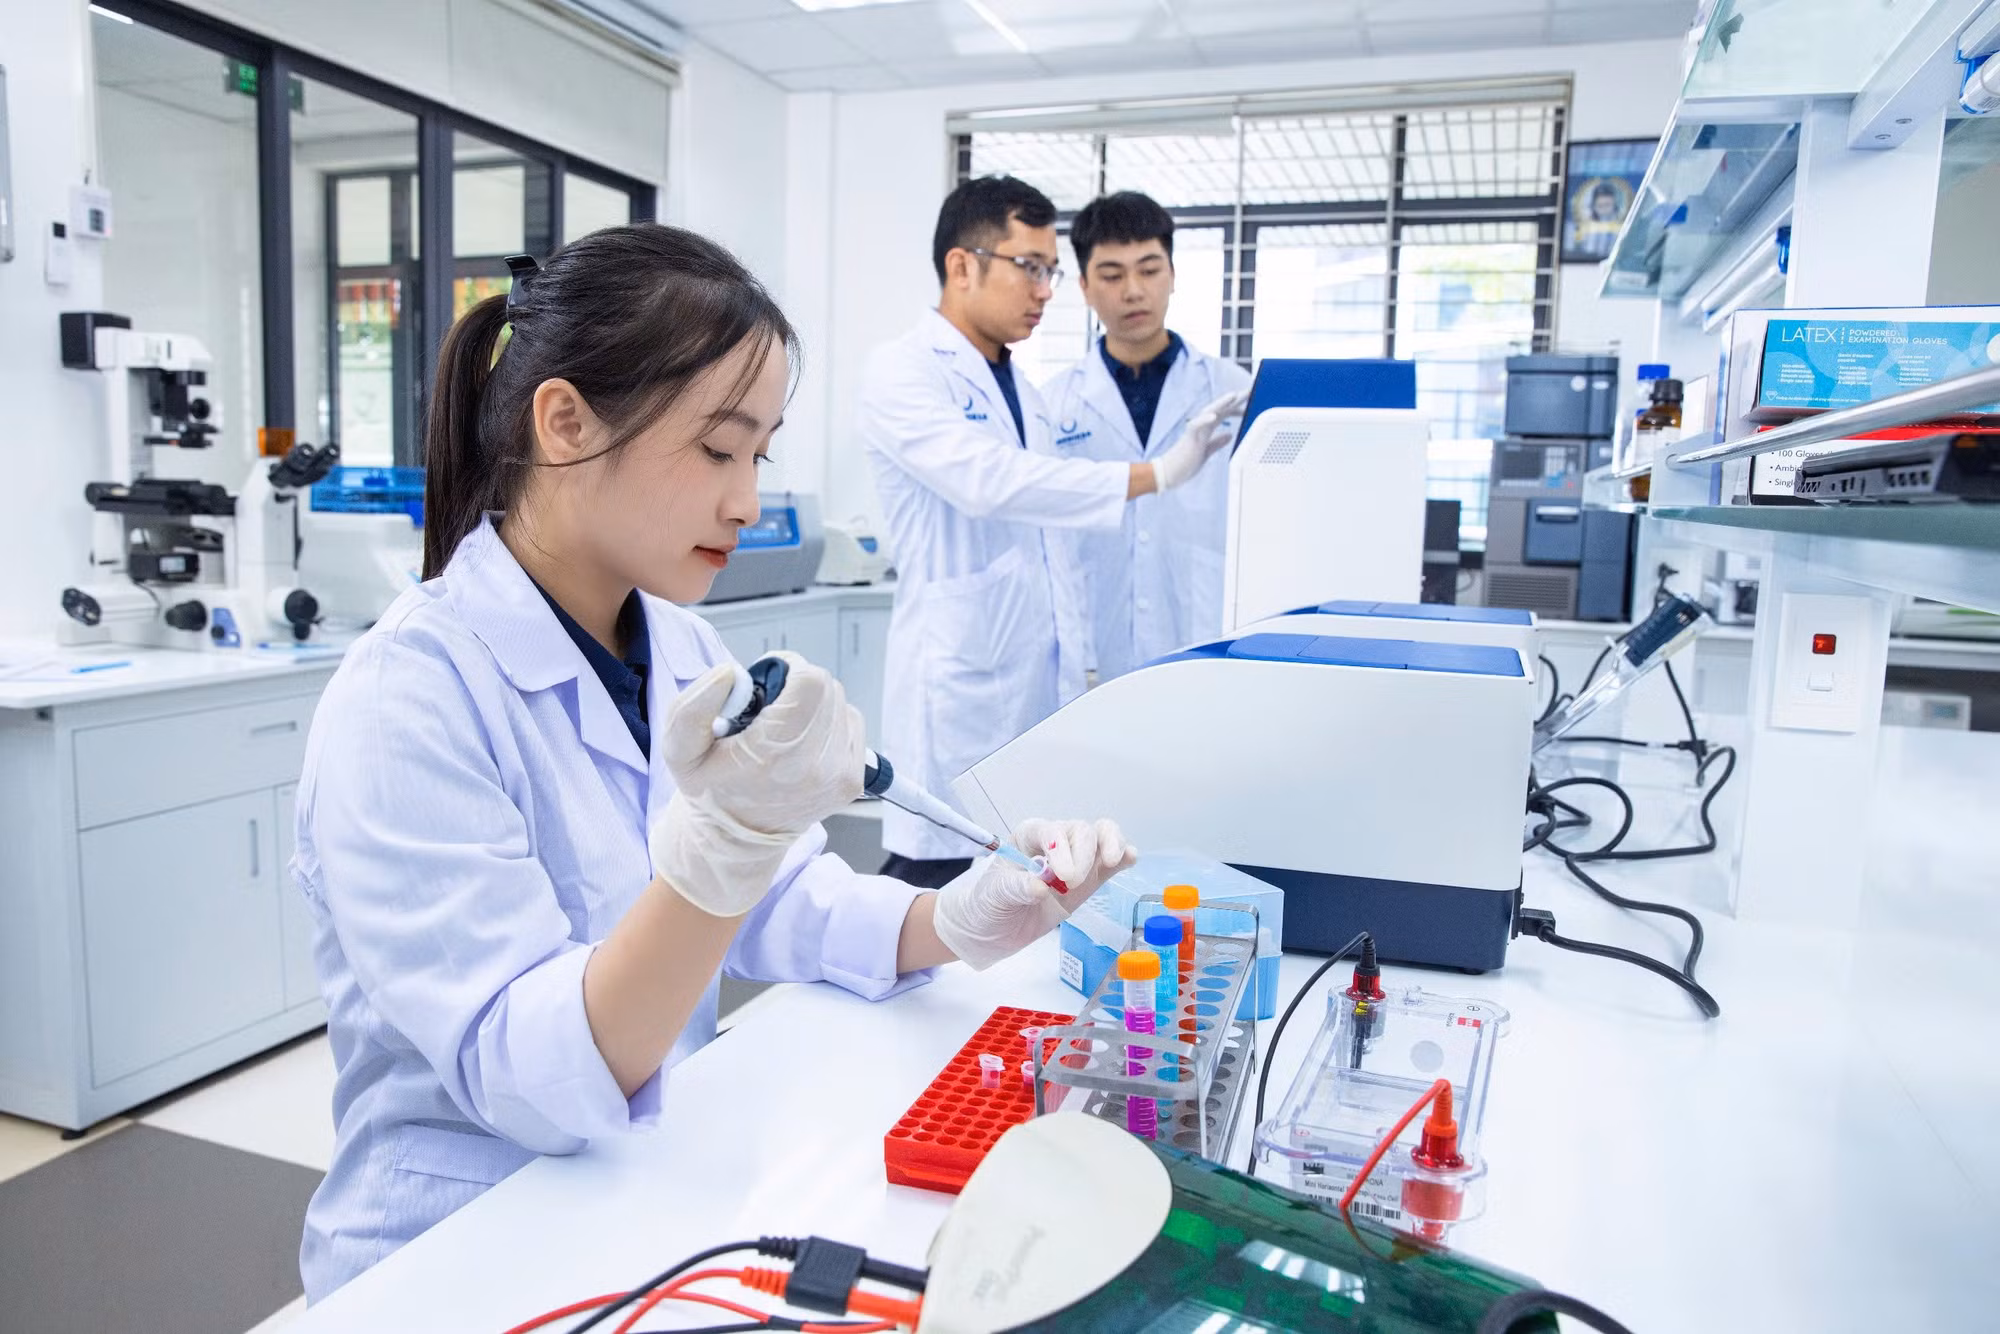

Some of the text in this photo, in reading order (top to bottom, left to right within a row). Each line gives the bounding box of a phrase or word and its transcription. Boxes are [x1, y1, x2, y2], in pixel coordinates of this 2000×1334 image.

[1782, 326, 1838, 343] LATEX
[1849, 329, 1896, 337] POWDERED
[1848, 336, 1908, 344] EXAMINATION
